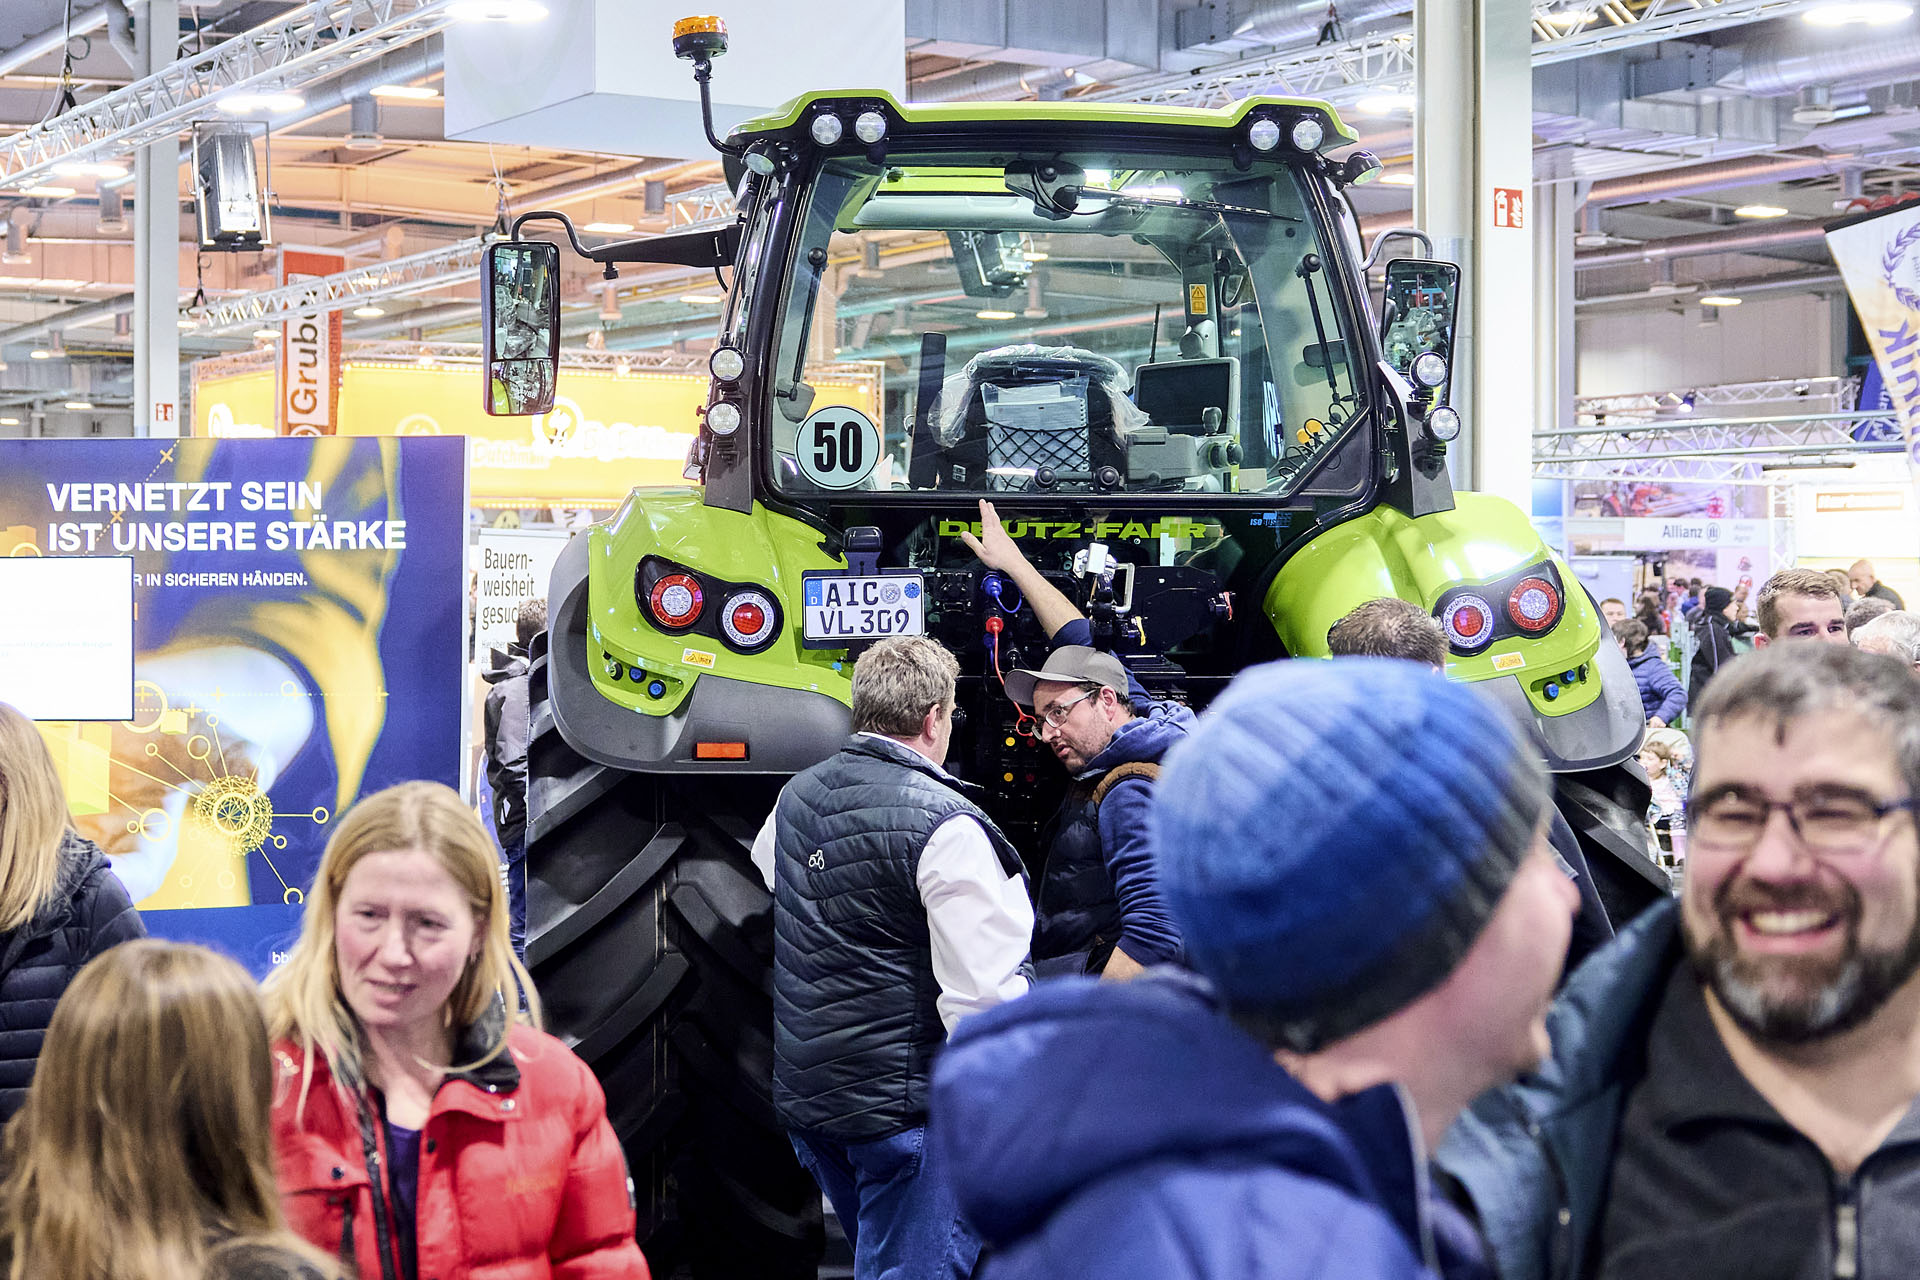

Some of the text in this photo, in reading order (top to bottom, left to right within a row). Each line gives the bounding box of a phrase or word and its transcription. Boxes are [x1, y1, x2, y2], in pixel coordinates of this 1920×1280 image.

[813, 422, 863, 472] 50
[47, 481, 322, 512] VERNETZT SEIN
[49, 514, 406, 551] IST UNSERE STÄRKE
[1662, 524, 1703, 540] Allianz
[484, 547, 533, 570] Bauern-
[146, 572, 161, 586] IN
[165, 572, 239, 587] SICHEREN
[243, 570, 308, 587] HÄNDEN.
[483, 573, 535, 598] weisheit
[825, 582, 879, 607] AIC
[482, 603, 520, 630] gesuc
[820, 609, 910, 634] VL 309
[272, 951, 292, 964] bb
